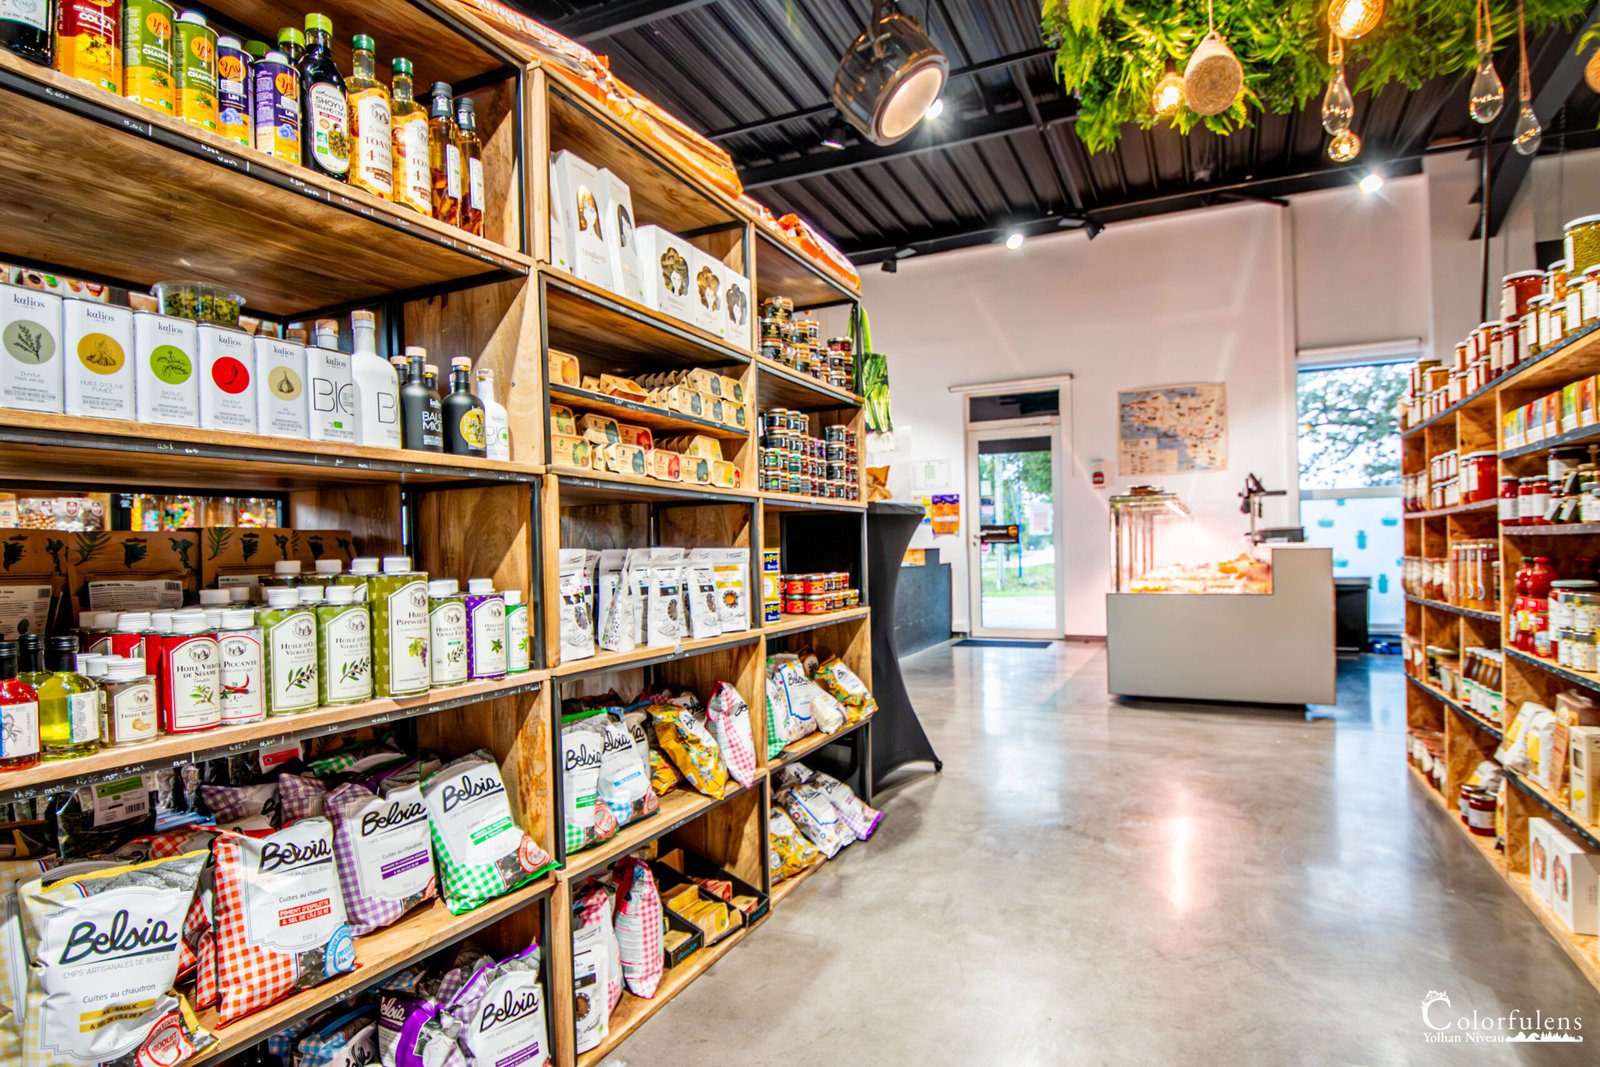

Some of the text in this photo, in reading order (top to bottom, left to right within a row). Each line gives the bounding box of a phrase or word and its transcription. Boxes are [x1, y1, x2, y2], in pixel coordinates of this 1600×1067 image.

[78, 12, 112, 30] COLZA
[316, 96, 344, 112] SHOYU
[14, 294, 45, 308] kalios
[86, 308, 115, 322] kalios
[158, 322, 184, 334] kalios
[218, 335, 242, 347] kalios
[274, 346, 294, 356] kalios
[326, 356, 346, 367] kalios
[224, 660, 257, 668] PICCANTE
[603, 730, 630, 754] elsia
[442, 775, 502, 813] Belsia
[362, 802, 428, 837] Belsia
[279, 895, 299, 903] Cuites
[308, 887, 328, 897] chaudron
[279, 908, 301, 917] PIMENT
[58, 909, 178, 965] Belsia
[63, 953, 170, 979] CHIPS ARTISANALES DE BEAUCE
[82, 993, 108, 1004] Cuites
[122, 984, 156, 996] chaudron
[115, 1003, 138, 1012] BASILIC
[480, 990, 538, 1033] Belsia
